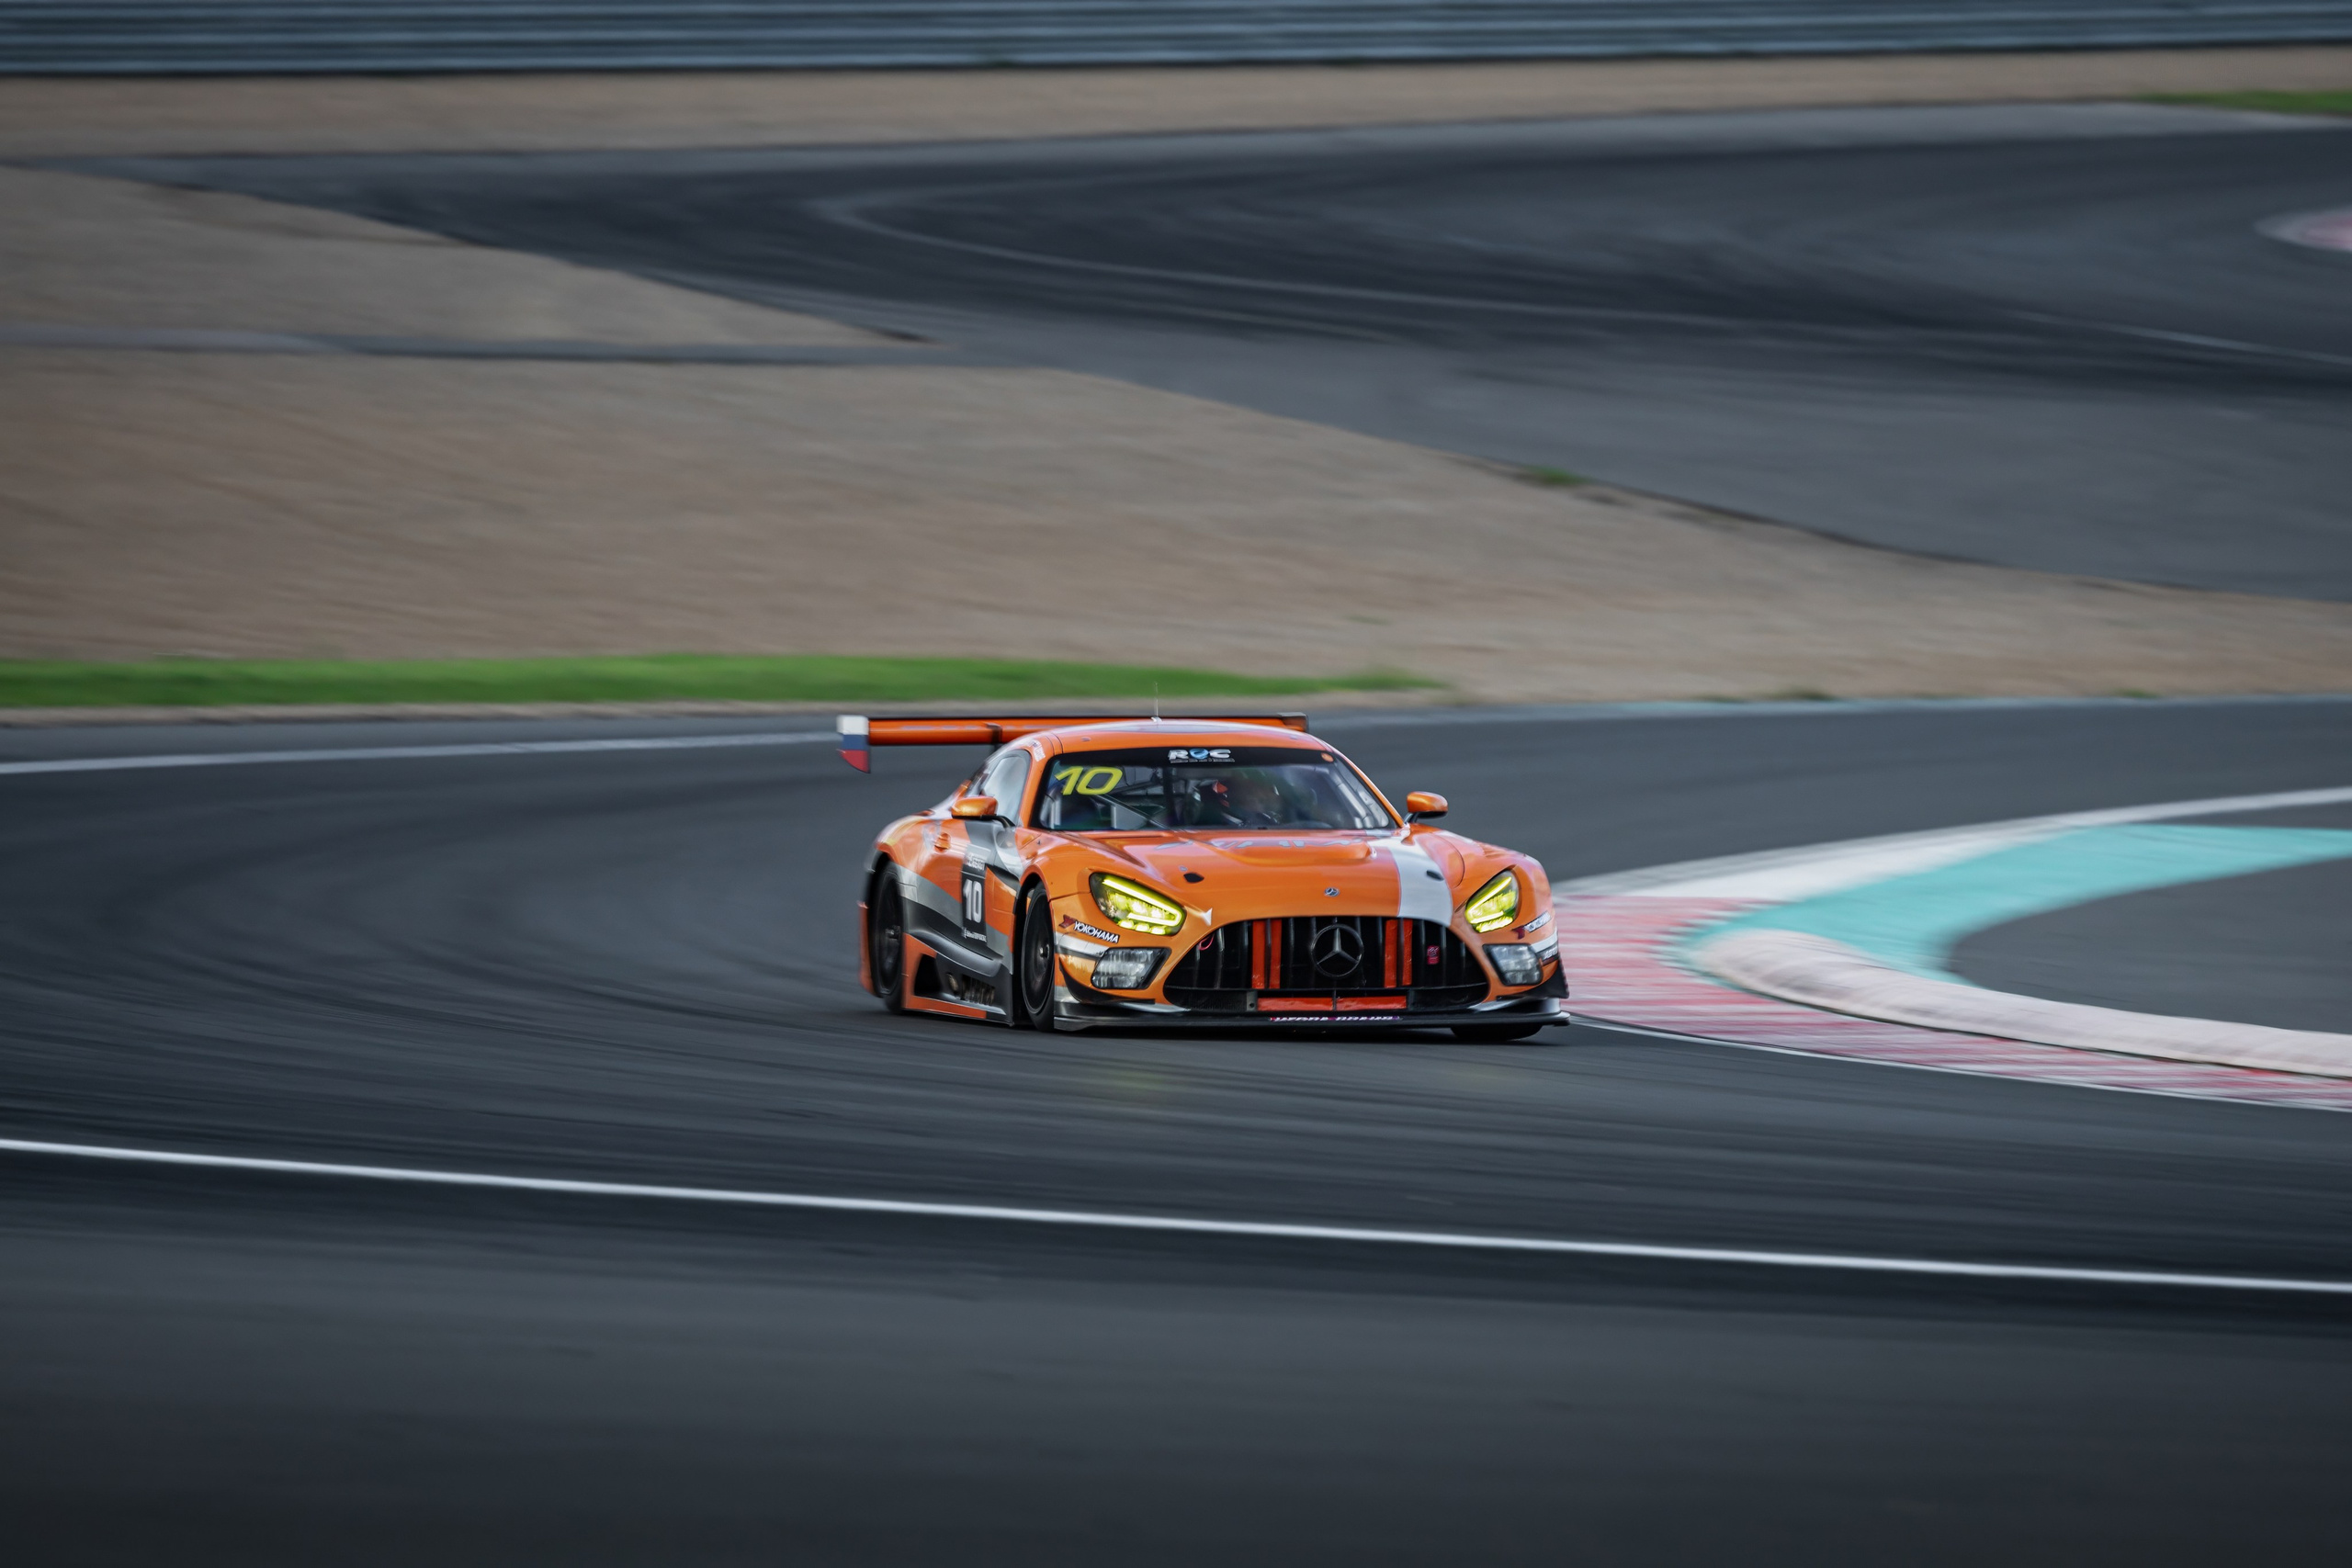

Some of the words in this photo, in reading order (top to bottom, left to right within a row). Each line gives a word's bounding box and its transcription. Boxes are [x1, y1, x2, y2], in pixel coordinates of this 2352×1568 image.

[1055, 766, 1123, 795] 10
[963, 879, 983, 923] 10
[1074, 920, 1119, 943] YOKOHAMA
